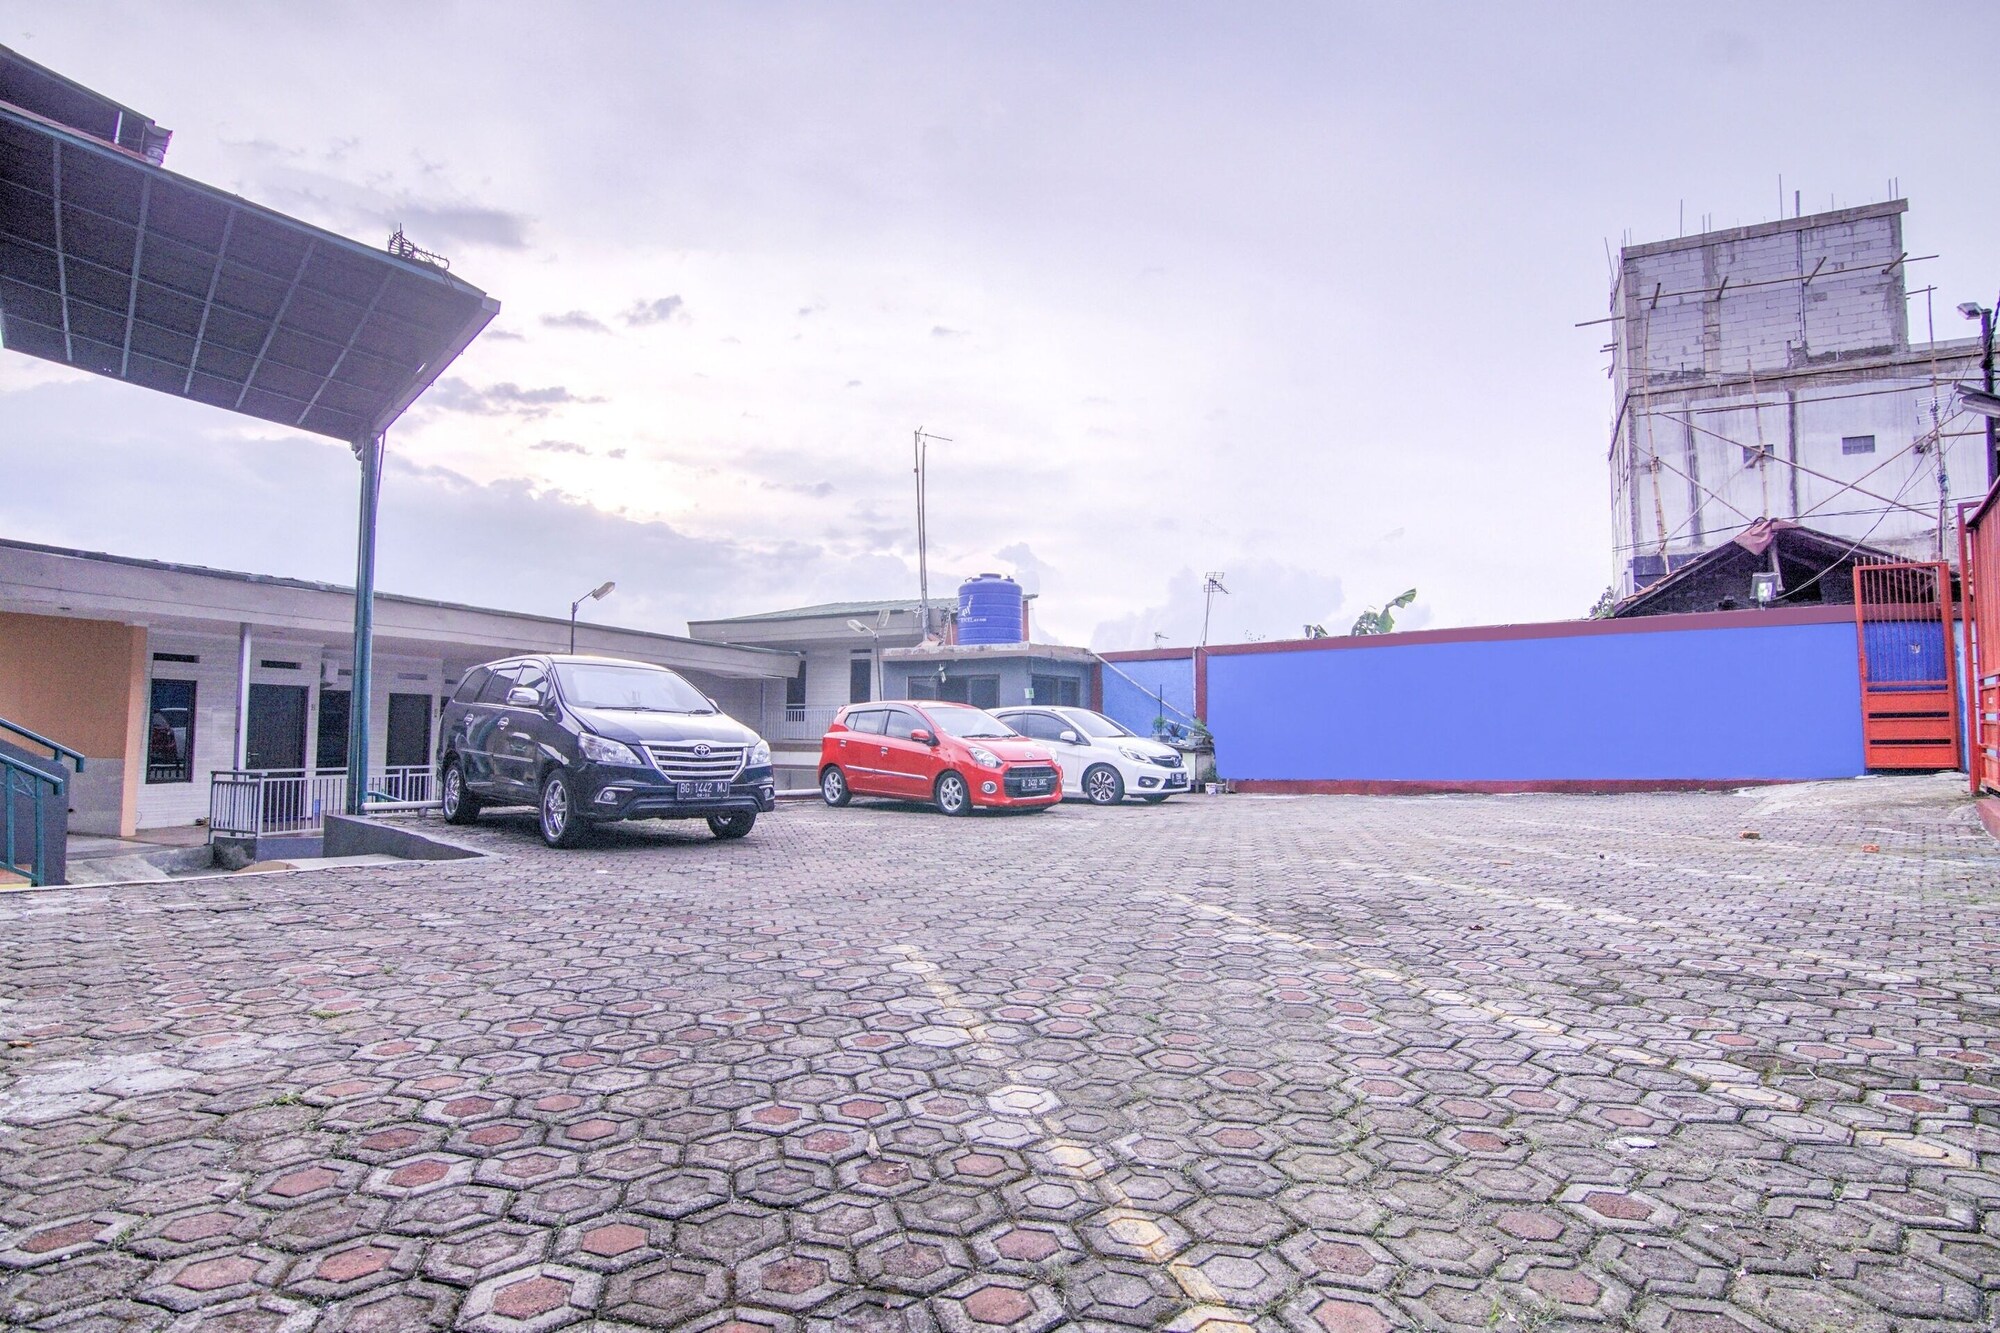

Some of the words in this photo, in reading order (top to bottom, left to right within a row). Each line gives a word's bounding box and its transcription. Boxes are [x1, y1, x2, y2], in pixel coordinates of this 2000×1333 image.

[680, 782, 690, 793] BG
[695, 782, 713, 793] 1442
[716, 782, 728, 793] MJ
